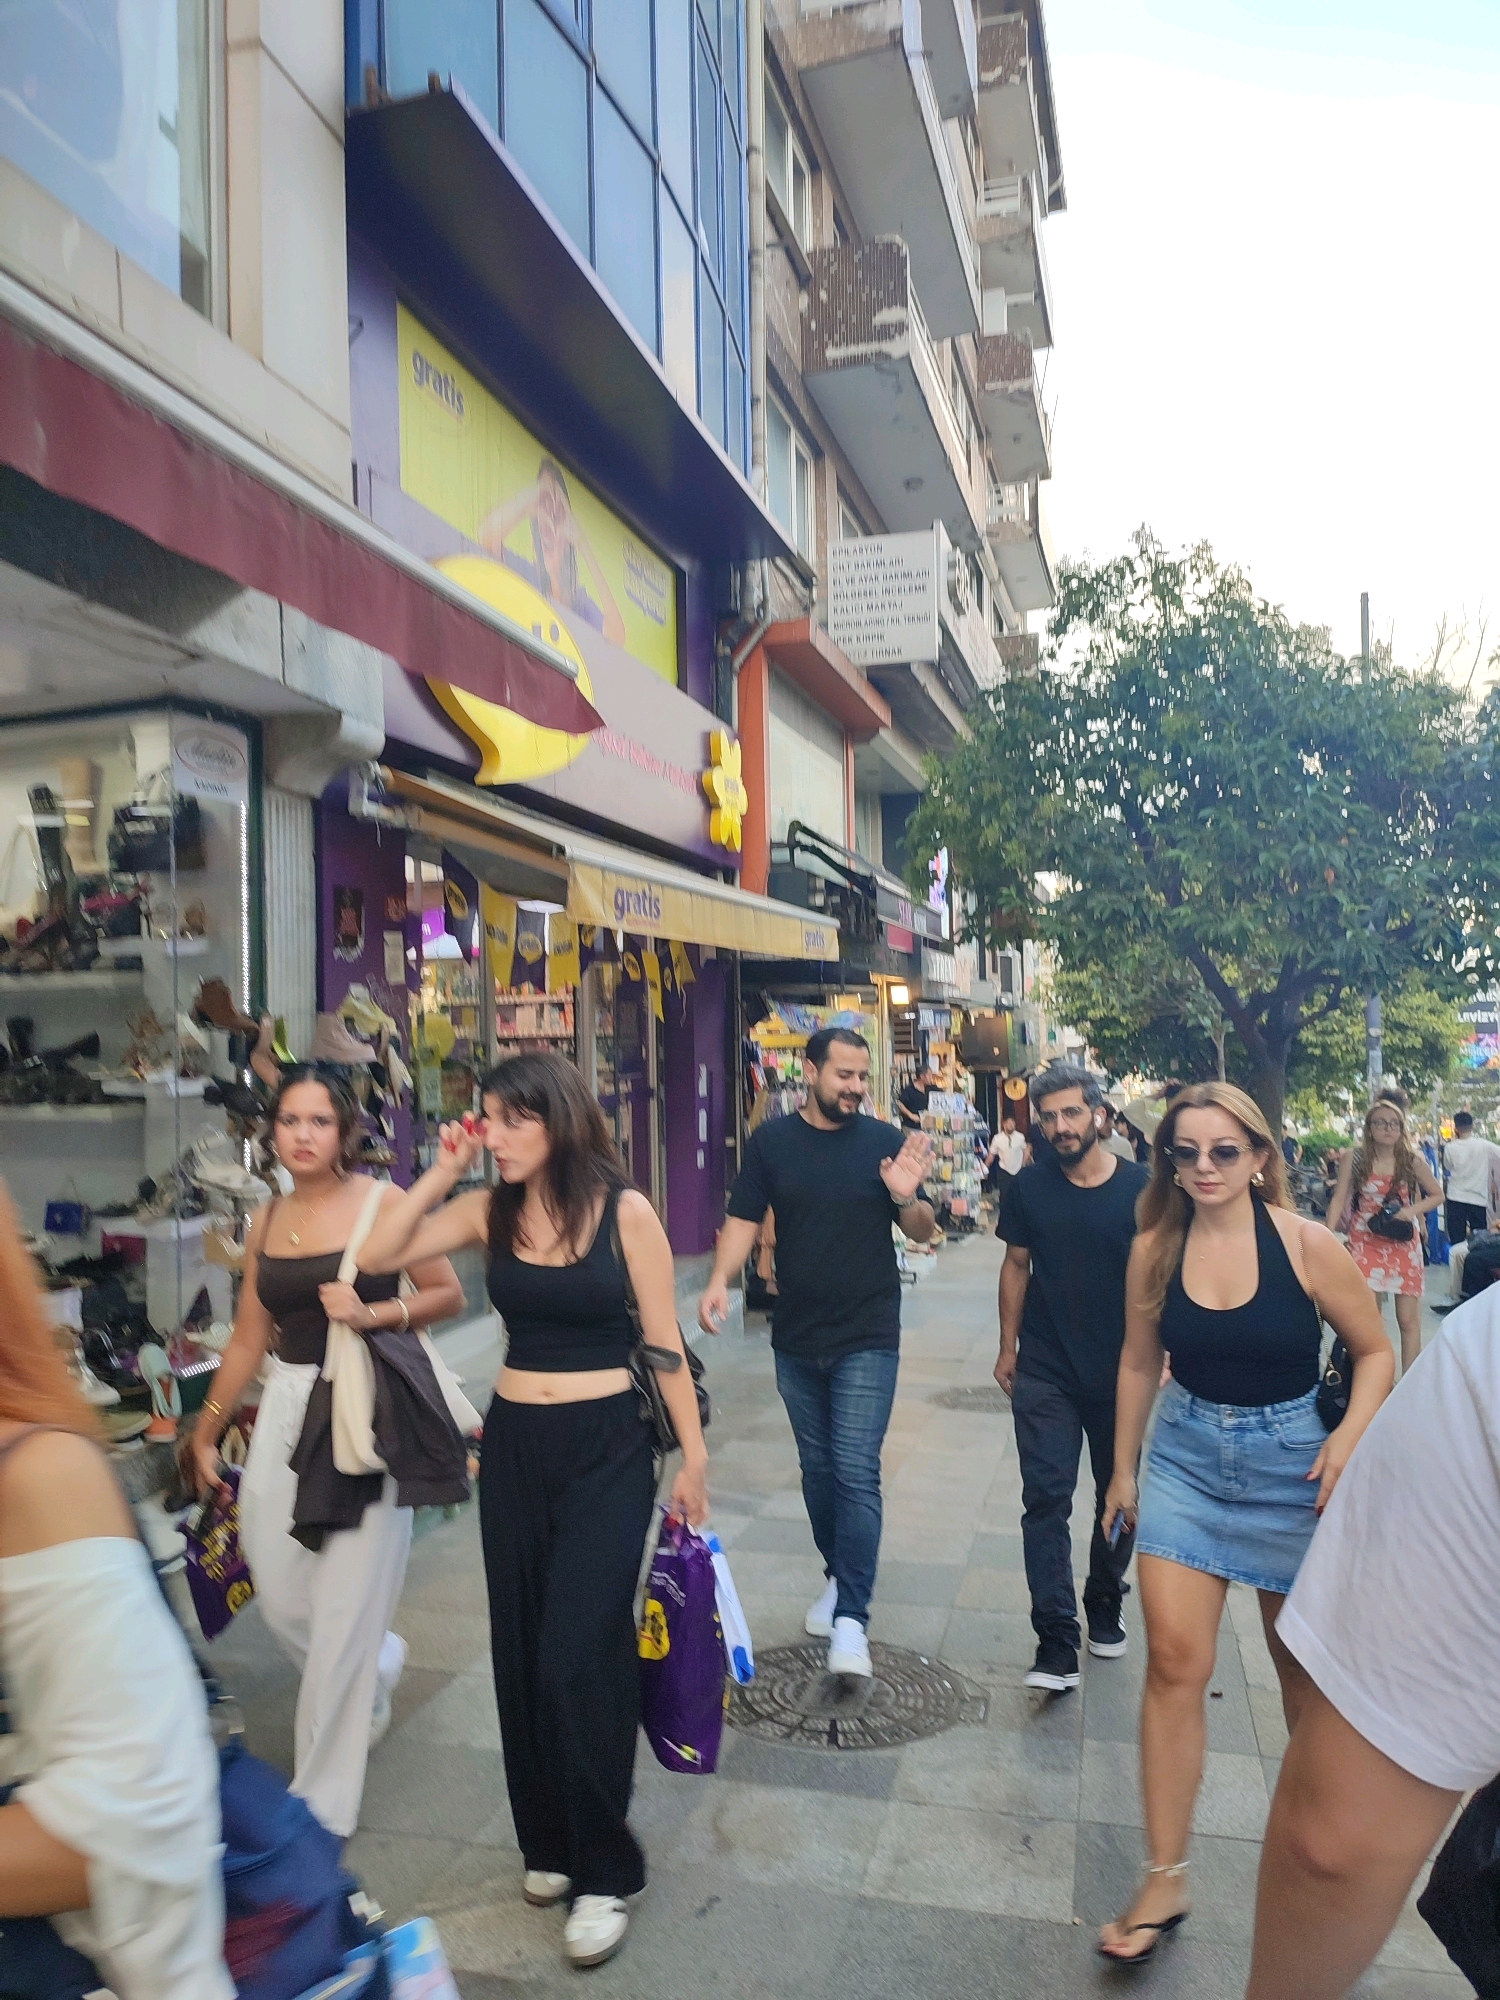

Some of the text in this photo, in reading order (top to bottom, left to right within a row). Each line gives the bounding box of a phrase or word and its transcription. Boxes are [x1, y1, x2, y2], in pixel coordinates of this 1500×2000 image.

[412, 348, 465, 417] gratis
[614, 883, 661, 921] gratis
[805, 926, 825, 952] gratis
